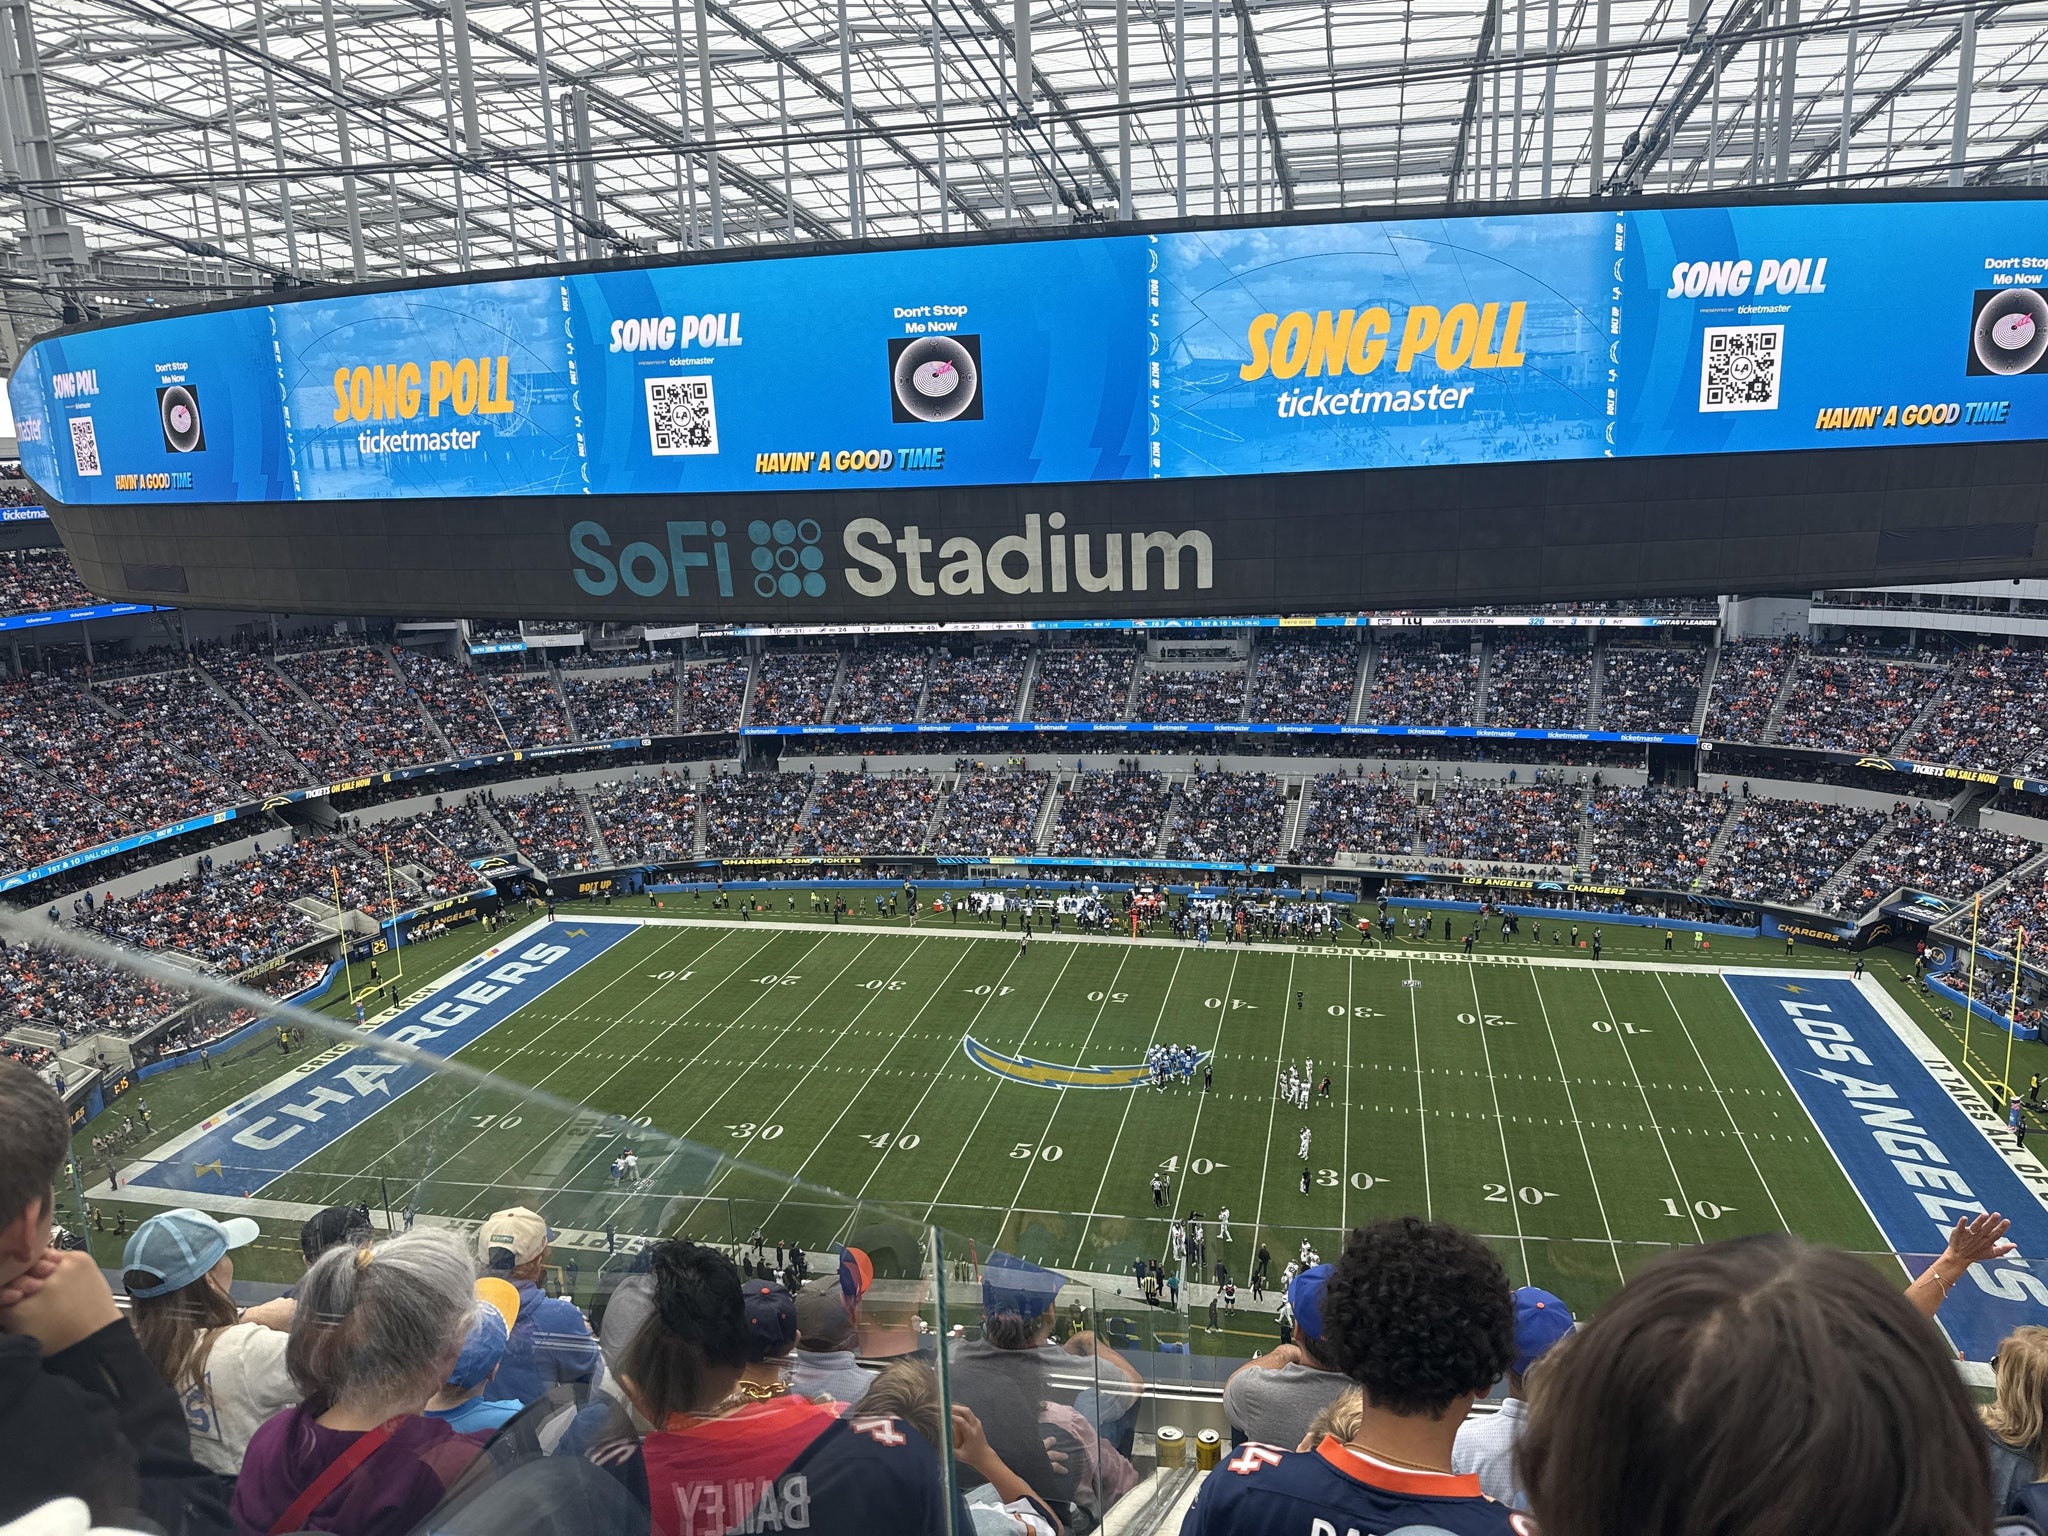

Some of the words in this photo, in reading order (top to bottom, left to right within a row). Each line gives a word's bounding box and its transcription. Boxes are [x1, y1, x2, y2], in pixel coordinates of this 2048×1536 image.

[1616, 222, 1624, 234] UP
[1615, 234, 1623, 252] BOLT
[1985, 257, 2018, 269] Don't
[1667, 259, 1753, 299] SONG
[1754, 257, 1828, 296] POLL
[1992, 273, 2013, 285] Me
[2014, 272, 2042, 285] Now
[1150, 279, 1159, 296] BOLT
[1612, 286, 1622, 301] LA
[1151, 296, 1159, 307] UP
[893, 307, 930, 319] Don't
[932, 304, 968, 319] Stop
[1611, 306, 1620, 317] UP
[1737, 304, 1791, 314] ticketmaster
[609, 316, 677, 353] SONG
[681, 312, 743, 349] POLL
[904, 322, 926, 334] Me
[927, 321, 958, 332] Now
[1611, 317, 1619, 335] BOLT
[1239, 306, 1391, 381] SONG
[1395, 301, 1527, 373] POLL
[155, 363, 172, 373] Don't
[172, 361, 189, 372] Stop
[669, 356, 715, 367] ticketmaster
[1151, 361, 1160, 379] BOLT
[1608, 369, 1618, 383] LA
[53, 373, 76, 399] SONG
[75, 369, 100, 397] POLL
[162, 375, 171, 384] Me
[172, 374, 186, 383] Now
[1151, 379, 1160, 389] UP
[333, 362, 422, 423] SONG
[429, 356, 515, 418] POLL
[1607, 388, 1616, 399] UP
[1276, 384, 1474, 419] ticketmaster
[1607, 399, 1615, 416] BOLT
[1814, 406, 1882, 431] HAVIN'
[1882, 406, 1898, 428] A
[1901, 403, 1961, 427] GOOD
[1964, 401, 2011, 425] TIME
[358, 427, 481, 454] ticketmaster
[755, 451, 816, 475] HAVIN'
[817, 451, 832, 472] A
[835, 448, 894, 472] GOOD
[898, 447, 946, 470] TIME
[1152, 457, 1161, 468] UP
[115, 474, 139, 491] HAVIN'
[139, 474, 147, 489] A
[147, 473, 171, 489] GOOD
[171, 472, 193, 488] TIME
[569, 519, 735, 598] SoFi
[842, 511, 1214, 598] Stadium
[1528, 617, 1545, 625] 326
[1153, 724, 1188, 732] ticketmaster
[1214, 724, 1250, 732] ticketmaster
[1276, 725, 1314, 733] ticketmaster
[1341, 726, 1380, 735] ticketmaster
[1407, 728, 1447, 736] ticketmaster
[1476, 729, 1517, 738] ticketmaster
[1547, 731, 1589, 740] ticketmaster
[1620, 734, 1664, 743] ticketmaster
[1912, 763, 1944, 777] TICKETS
[1944, 769, 1956, 778] ON
[1956, 770, 1977, 781] SALE
[1977, 773, 1999, 785] NOW
[305, 786, 330, 800] TICKETS
[331, 785, 341, 794] ON
[341, 782, 355, 792] SALE
[355, 777, 371, 789] NOW
[47, 864, 62, 874] 1ST
[62, 861, 69, 870] &
[69, 857, 81, 867] 10
[84, 852, 100, 863] BALL
[100, 848, 110, 857] ON
[722, 857, 861, 866] CHARGERS.COM/TICKETS
[26, 871, 38, 880] 10
[1462, 876, 1482, 885] LOS
[1483, 878, 1534, 889] ANGELES
[600, 879, 612, 891] UP
[1566, 884, 1626, 896] CHARGERS
[446, 900, 454, 908] UP
[432, 907, 477, 928] ANGELES
[1777, 922, 1840, 943] CHARGERS
[373, 940, 386, 952] 25
[1296, 945, 1387, 957] CANCER
[1398, 951, 1529, 964] INTERCEPT
[242, 956, 286, 983] CHARGERS
[655, 970, 697, 981] 10
[758, 974, 802, 986] 20
[862, 979, 907, 991] 30
[974, 985, 1016, 996] 40
[1087, 991, 1129, 1003] 50
[381, 986, 440, 1018] CATCH
[1204, 998, 1247, 1010] 40
[1327, 1005, 1374, 1018] 30
[1456, 1012, 1505, 1027] 20
[1592, 1020, 1639, 1035] 10
[1779, 999, 1874, 1067] LOS
[232, 942, 571, 1151] CHARGERS
[476, 1114, 523, 1130] 10
[1923, 1058, 1952, 1075] IT
[1942, 1075, 1996, 1122] TAKES
[1985, 1128, 2027, 1156] ALL
[2015, 1162, 2046, 1189] OF
[731, 1122, 784, 1140] 30
[867, 1131, 921, 1150] 40
[1009, 1142, 1063, 1162] 50
[1159, 1155, 1214, 1175] 40
[1316, 1168, 1375, 1191] 30
[1482, 1183, 1544, 1206] 20
[1659, 1197, 1721, 1220] 10
[1227, 1445, 1283, 1476] 4
